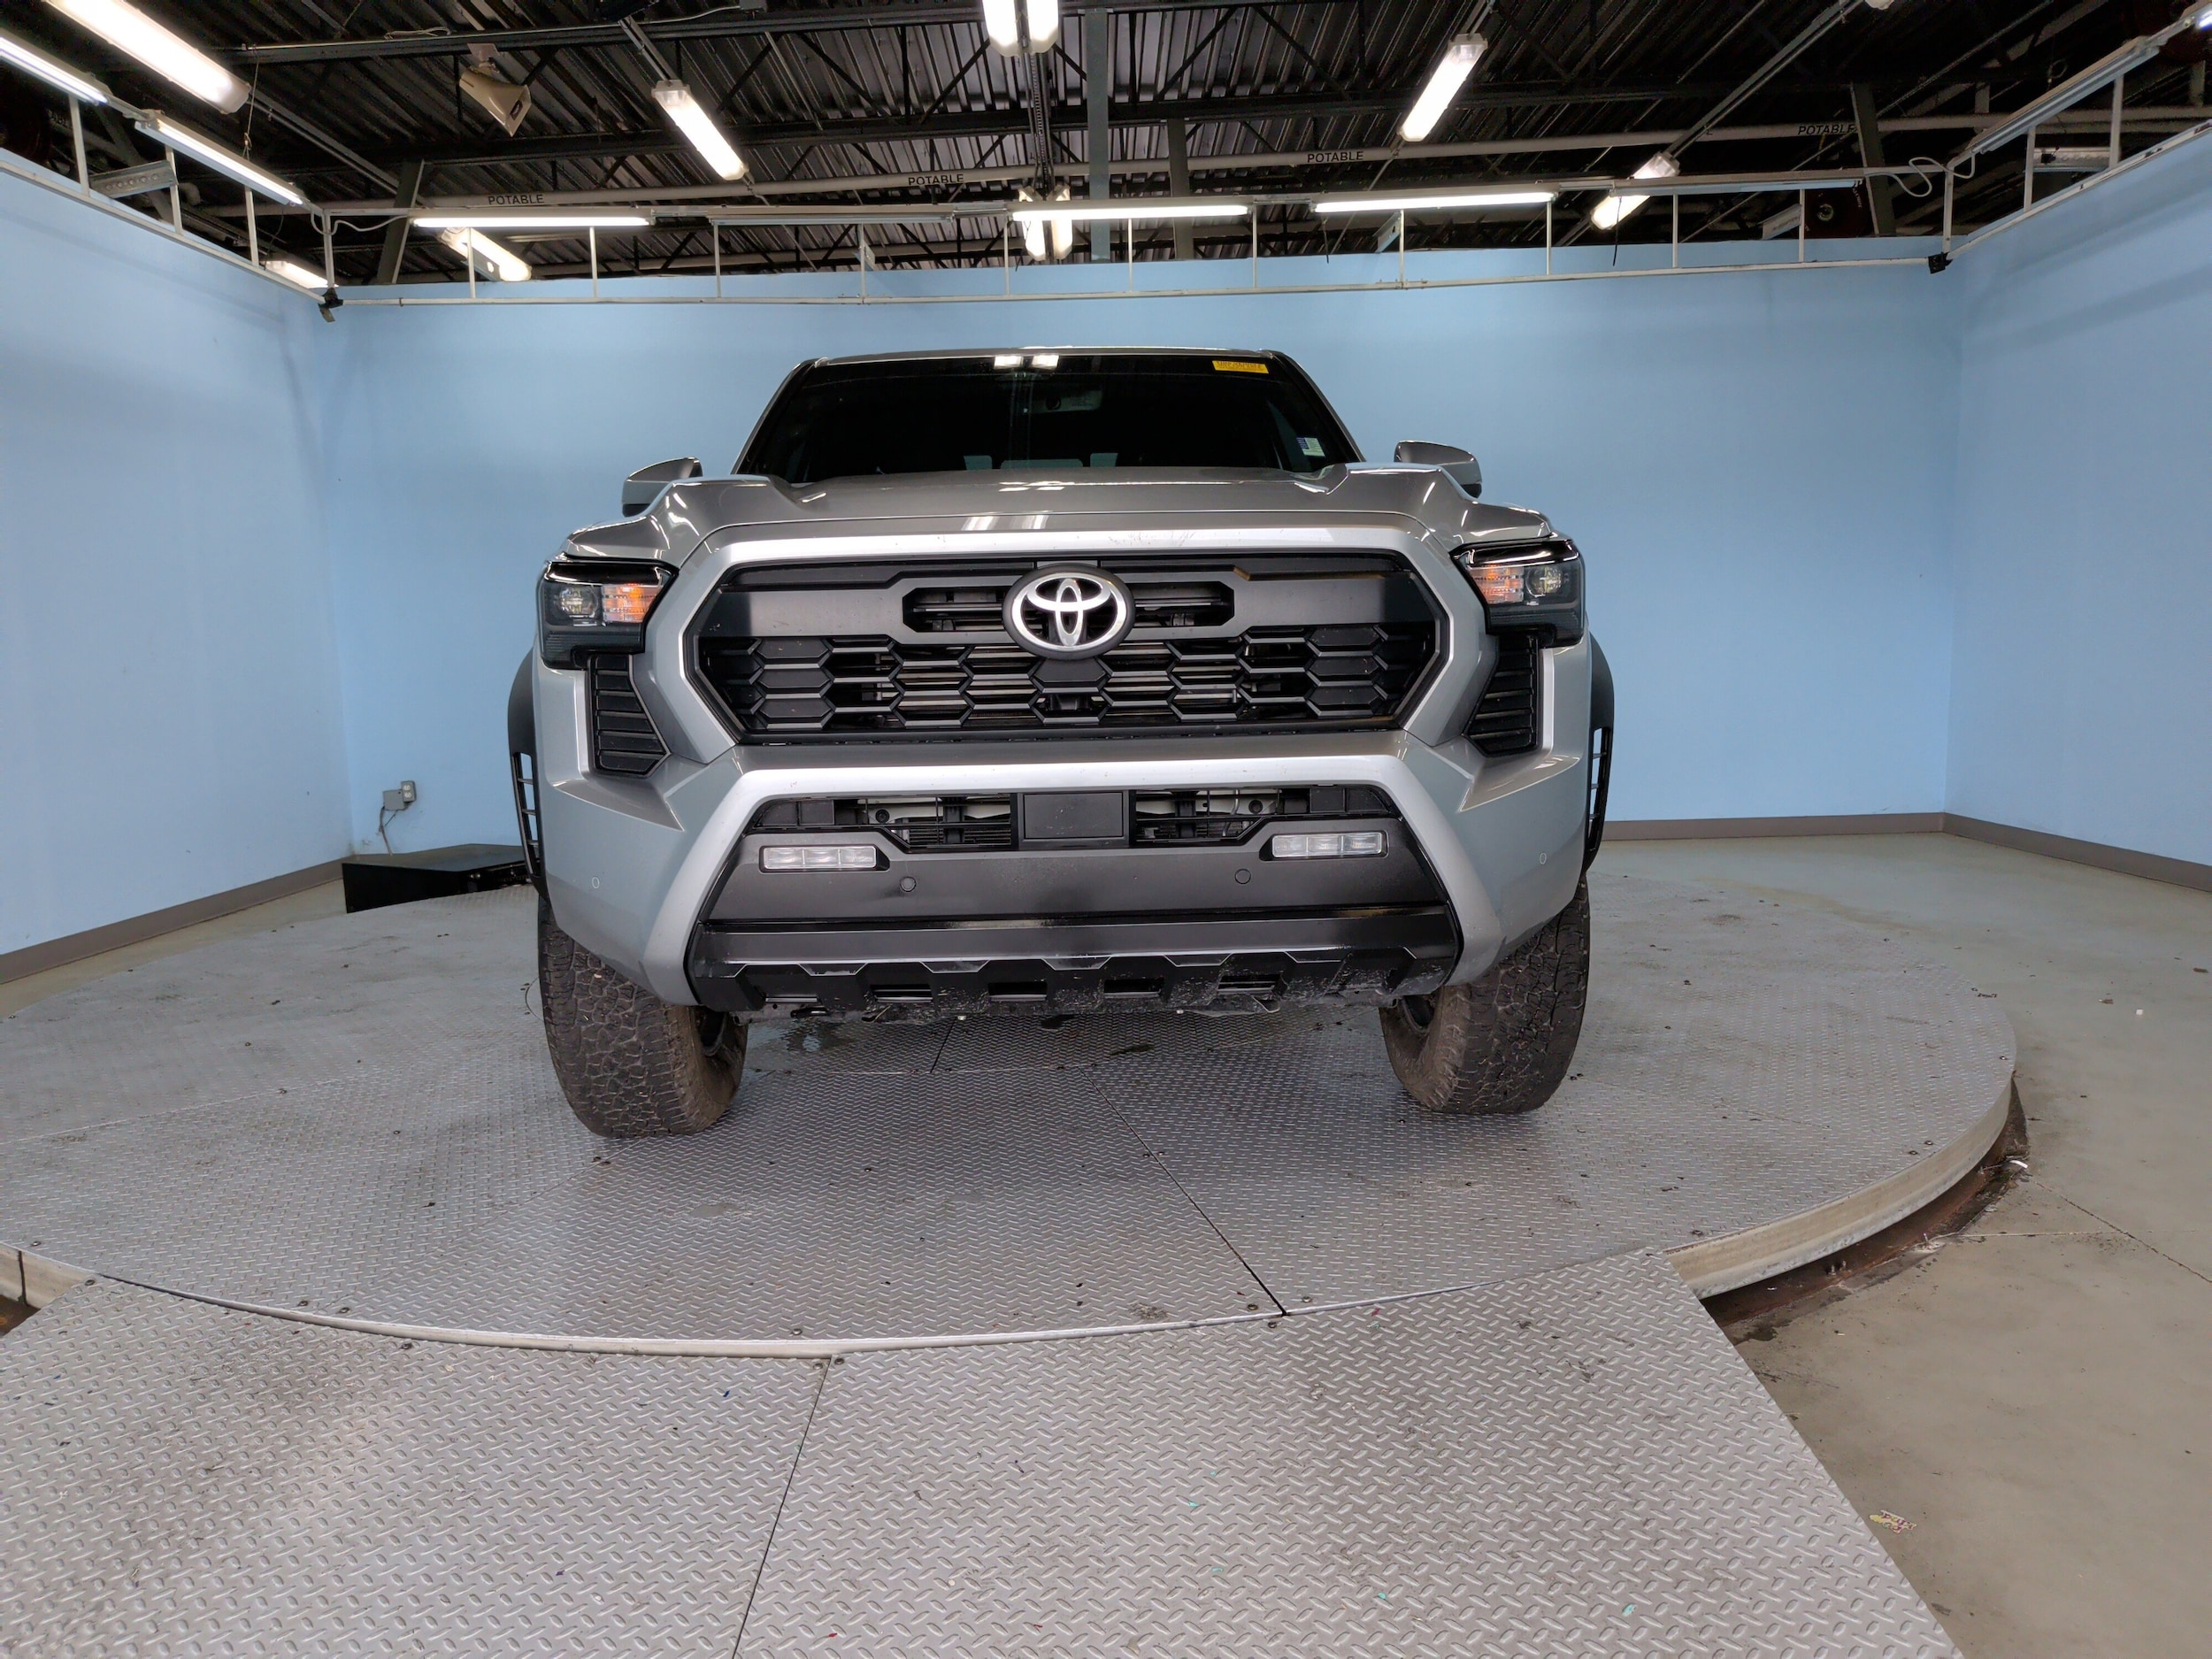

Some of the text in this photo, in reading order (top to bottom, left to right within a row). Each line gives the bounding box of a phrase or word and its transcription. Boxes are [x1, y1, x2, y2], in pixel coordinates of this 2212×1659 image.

[1307, 150, 1364, 163] POTABLE
[908, 173, 964, 185] POTABLE
[488, 194, 545, 205] POTABLE
